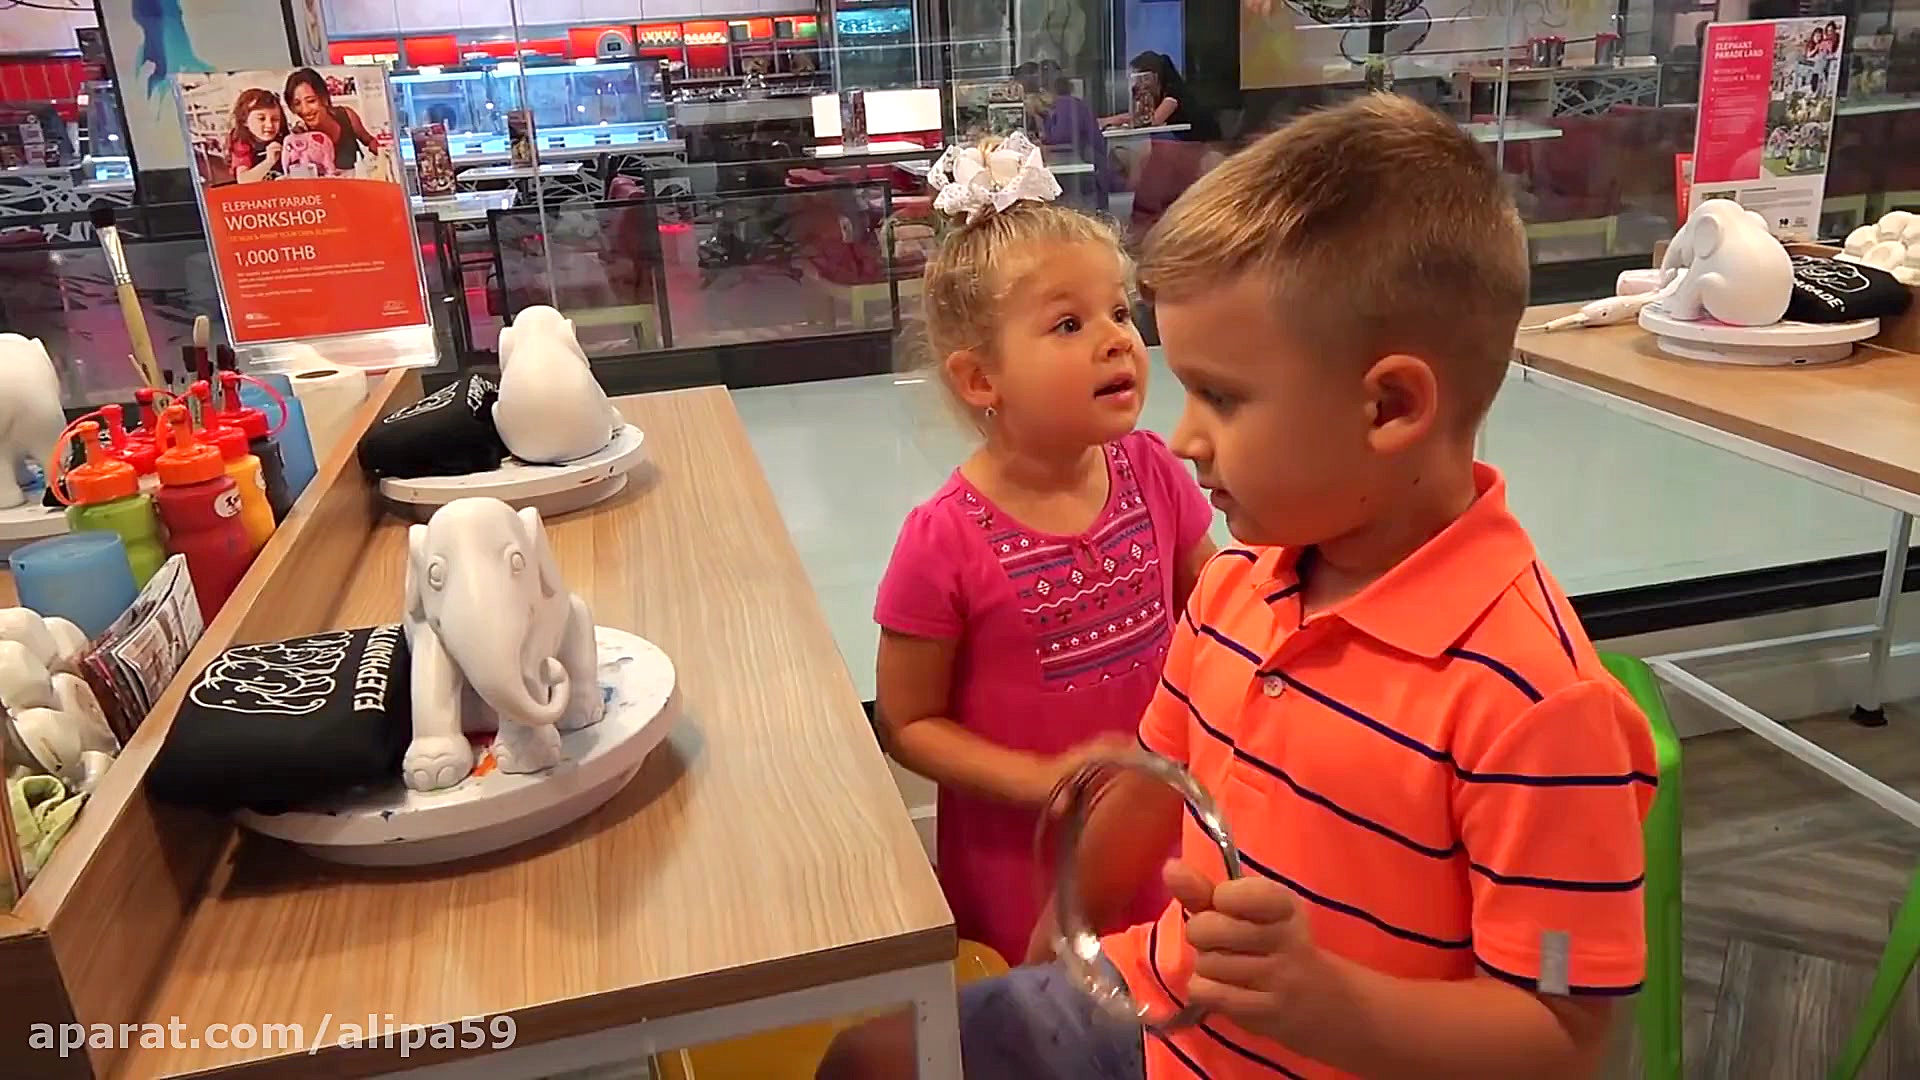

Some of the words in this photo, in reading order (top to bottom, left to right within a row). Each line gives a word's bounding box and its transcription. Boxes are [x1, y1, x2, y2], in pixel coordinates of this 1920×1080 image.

[221, 198, 277, 213] ELEPHANT
[279, 195, 323, 208] PARADE
[224, 208, 327, 231] WORKSHOP
[234, 248, 279, 267] 1,000
[280, 245, 317, 261] THB
[1793, 277, 1844, 308] ARADE
[353, 636, 398, 712] ELEPHANT
